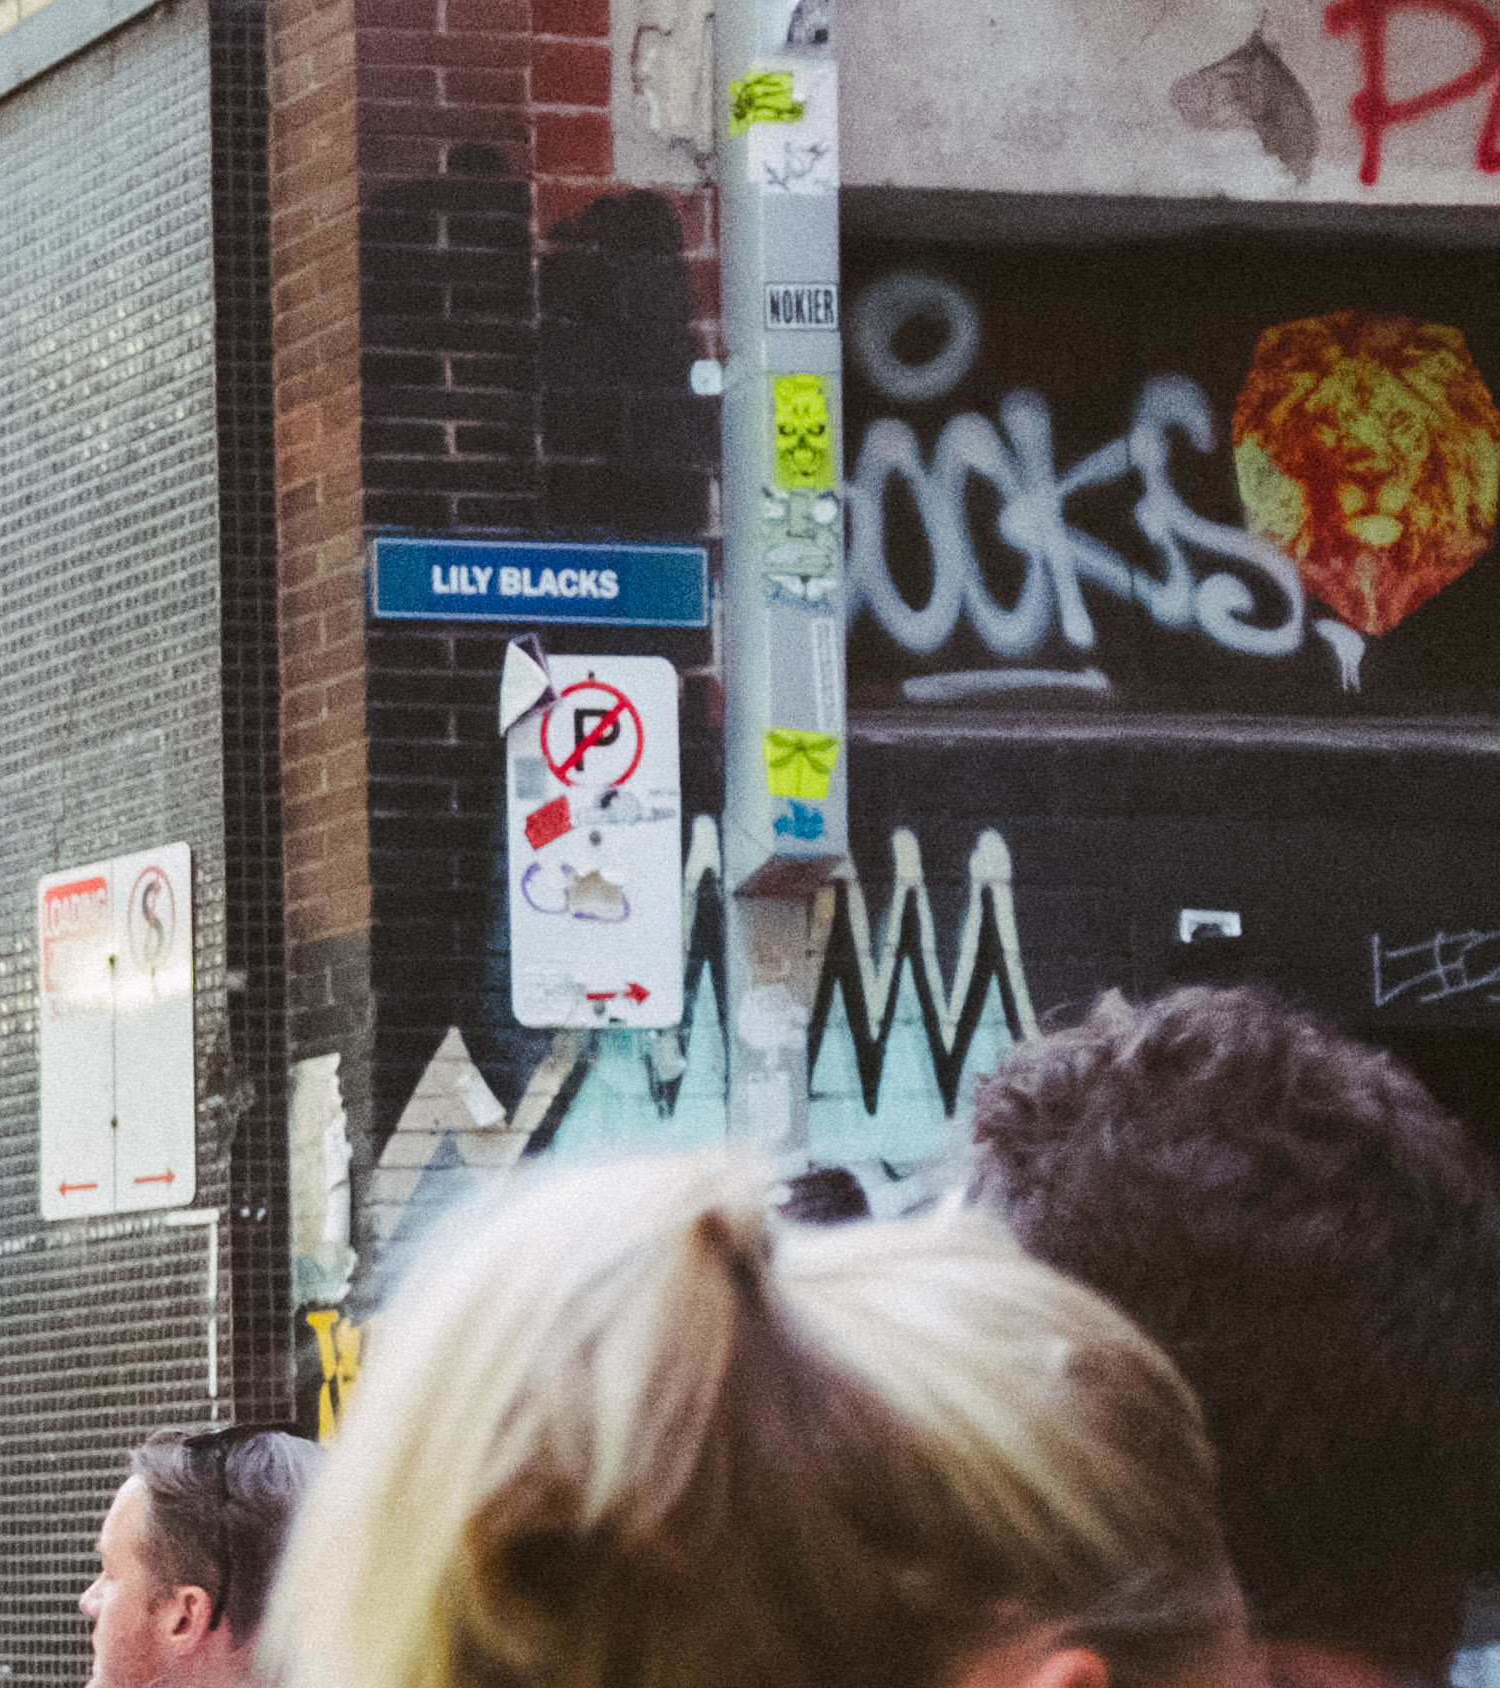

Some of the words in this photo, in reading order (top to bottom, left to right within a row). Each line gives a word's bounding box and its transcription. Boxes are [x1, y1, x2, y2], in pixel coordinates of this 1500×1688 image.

[769, 288, 835, 325] NOKIER
[431, 564, 494, 596] LILY
[499, 566, 621, 600] BLACKS
